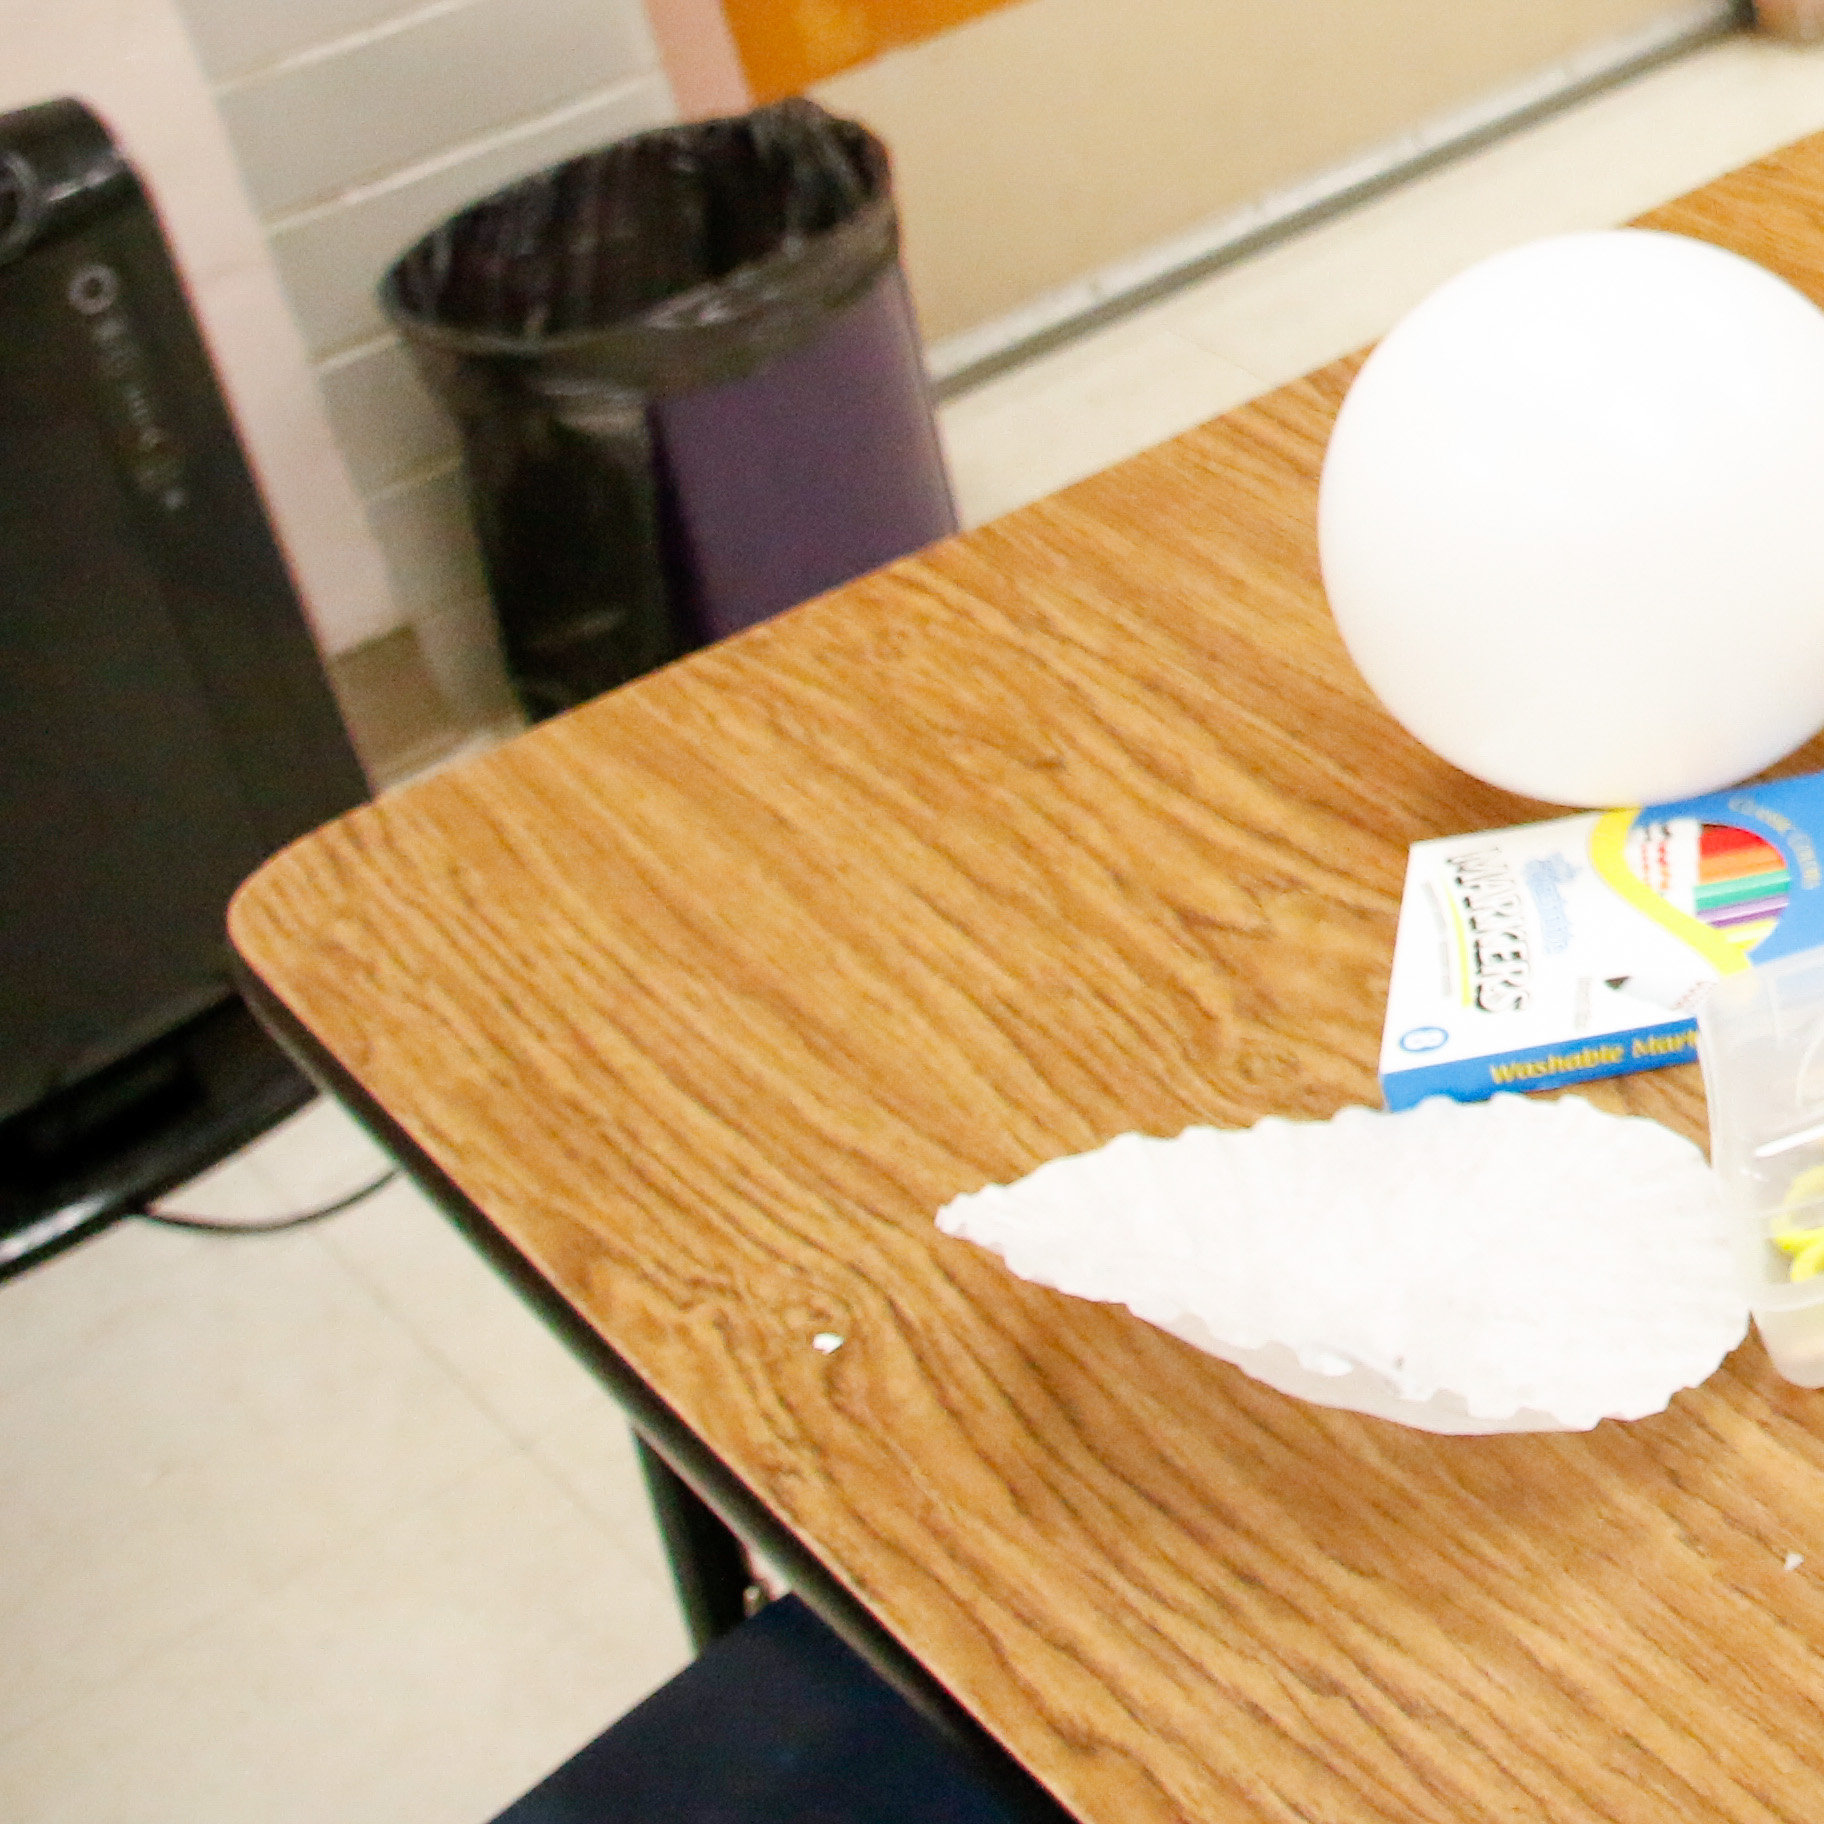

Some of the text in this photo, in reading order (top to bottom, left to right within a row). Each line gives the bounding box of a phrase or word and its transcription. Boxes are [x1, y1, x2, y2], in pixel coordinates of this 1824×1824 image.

[1446, 845, 1531, 1013] MARKERS
[1490, 1029, 1698, 1084] Washable Mark
